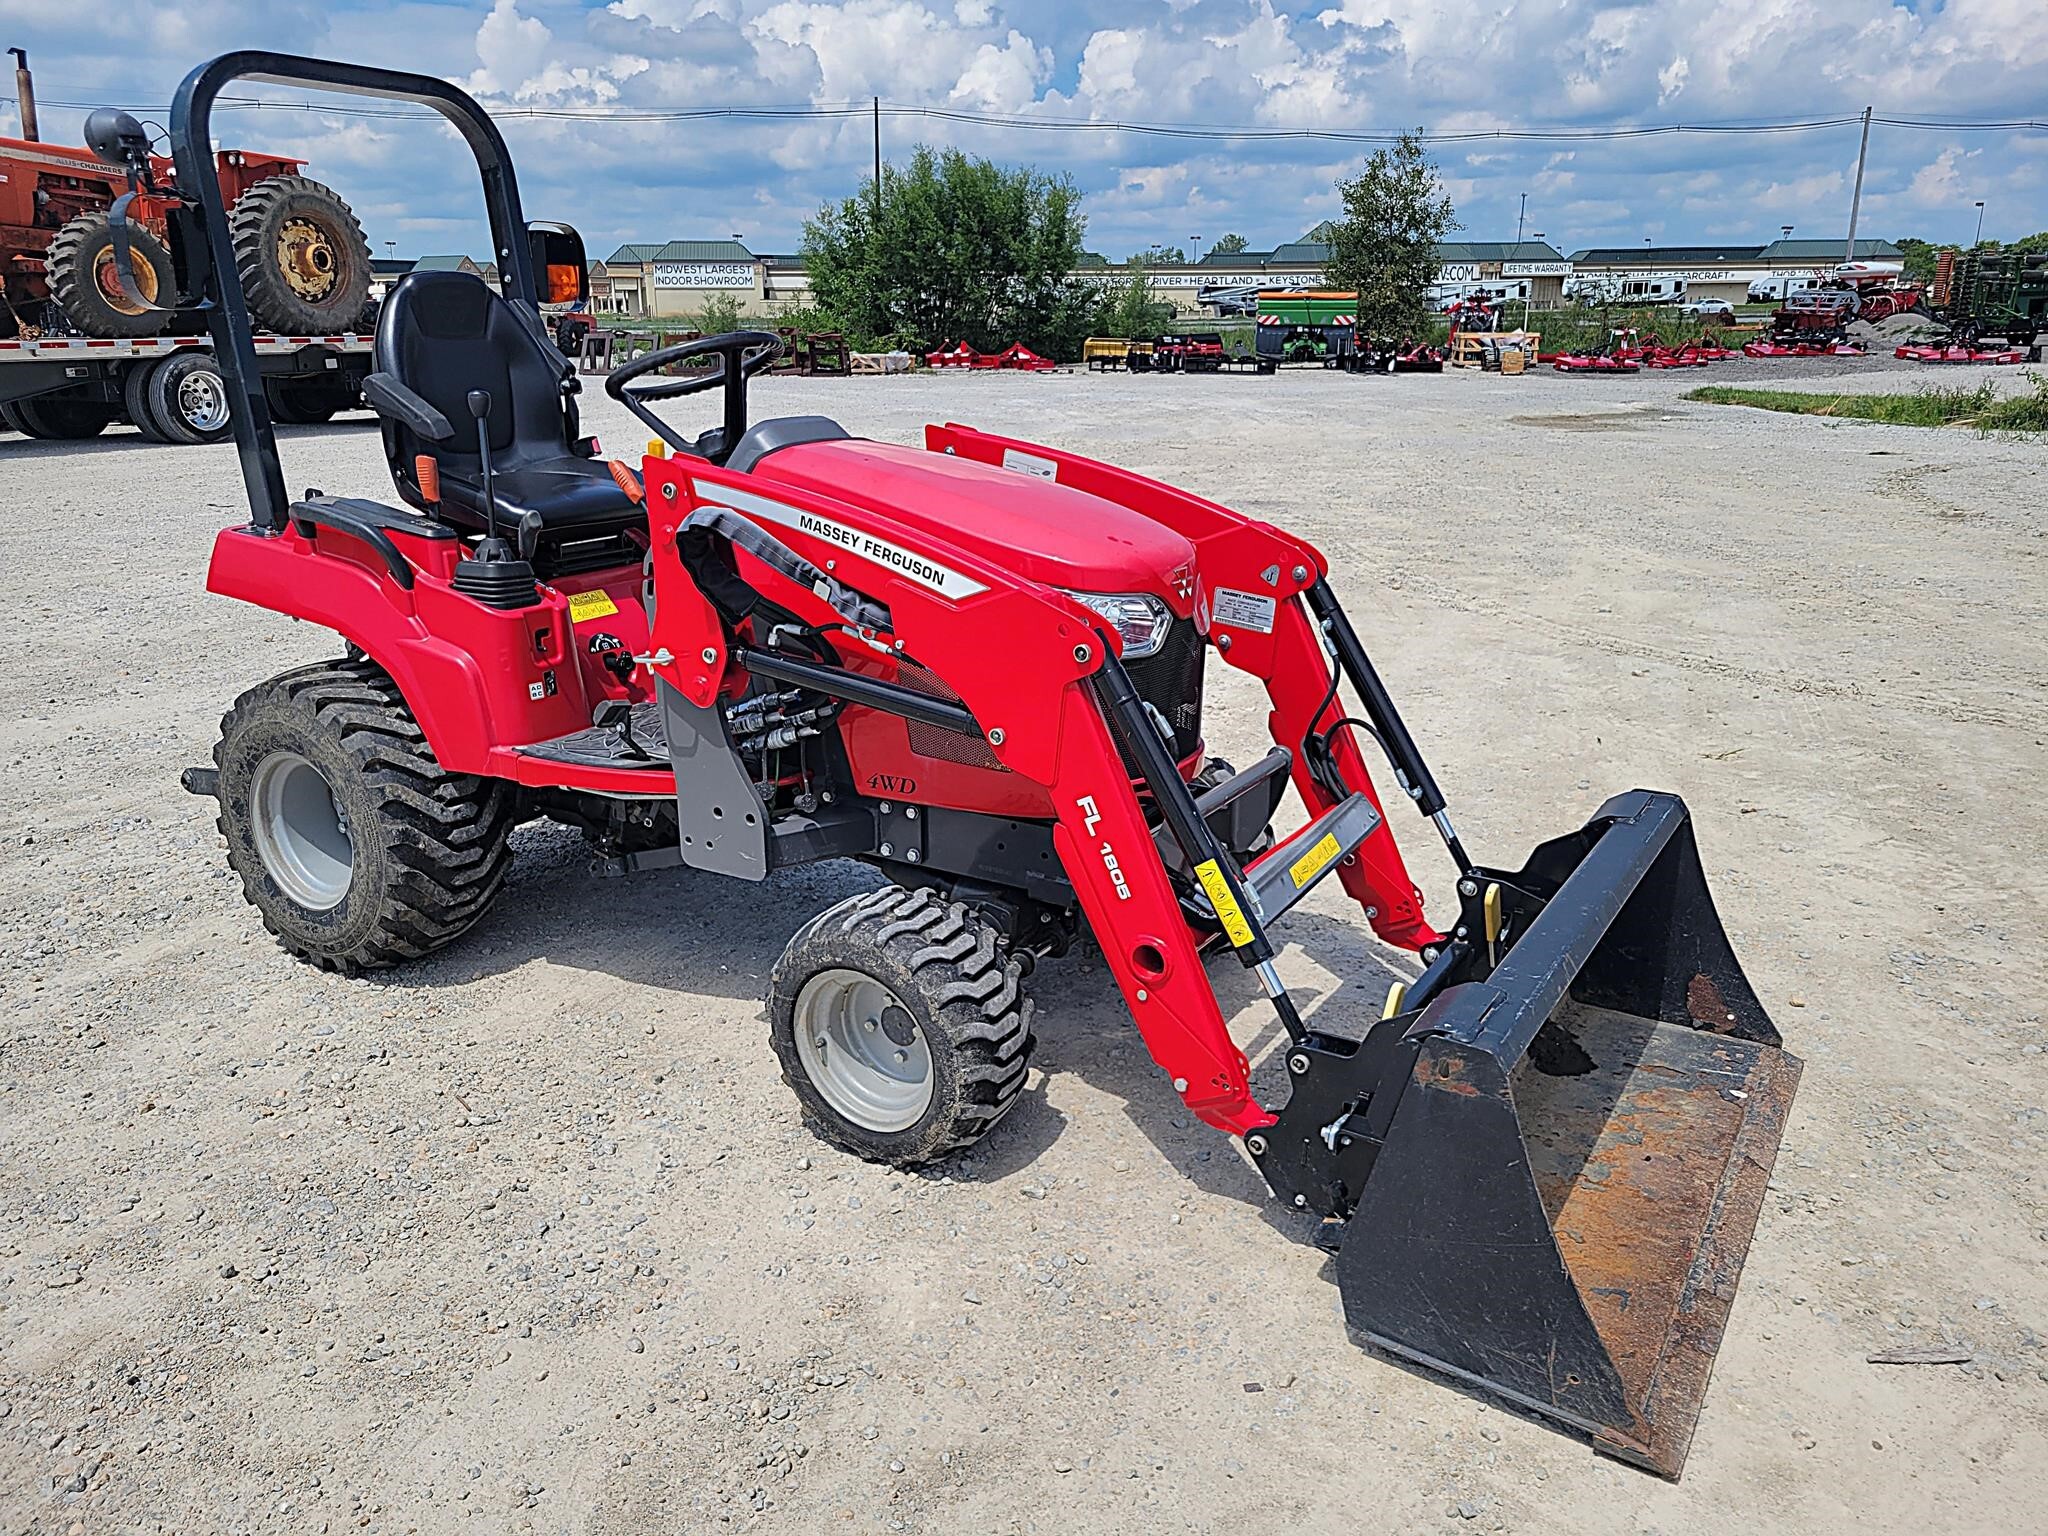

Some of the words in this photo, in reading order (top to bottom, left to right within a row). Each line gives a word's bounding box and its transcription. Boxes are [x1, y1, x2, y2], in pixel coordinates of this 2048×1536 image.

[55, 158, 123, 174] ALLIS-CHALMERS
[655, 265, 702, 274] MIDWEST
[705, 265, 751, 274] LARGEST
[1503, 264, 1532, 273] LIFETIME
[1534, 264, 1572, 273] WARRANTY
[655, 276, 692, 285] INDOOR
[694, 276, 753, 285] SHOWROOM
[1153, 277, 1182, 285] RIVER
[1190, 276, 1253, 285] HEARTLAND
[1269, 275, 1321, 285] KEYSTONE
[799, 515, 860, 549] MASSEY
[863, 539, 945, 586] FERGUSON
[865, 772, 916, 794] 4WD
[1076, 795, 1101, 837] FL
[1100, 841, 1132, 900] 1805
